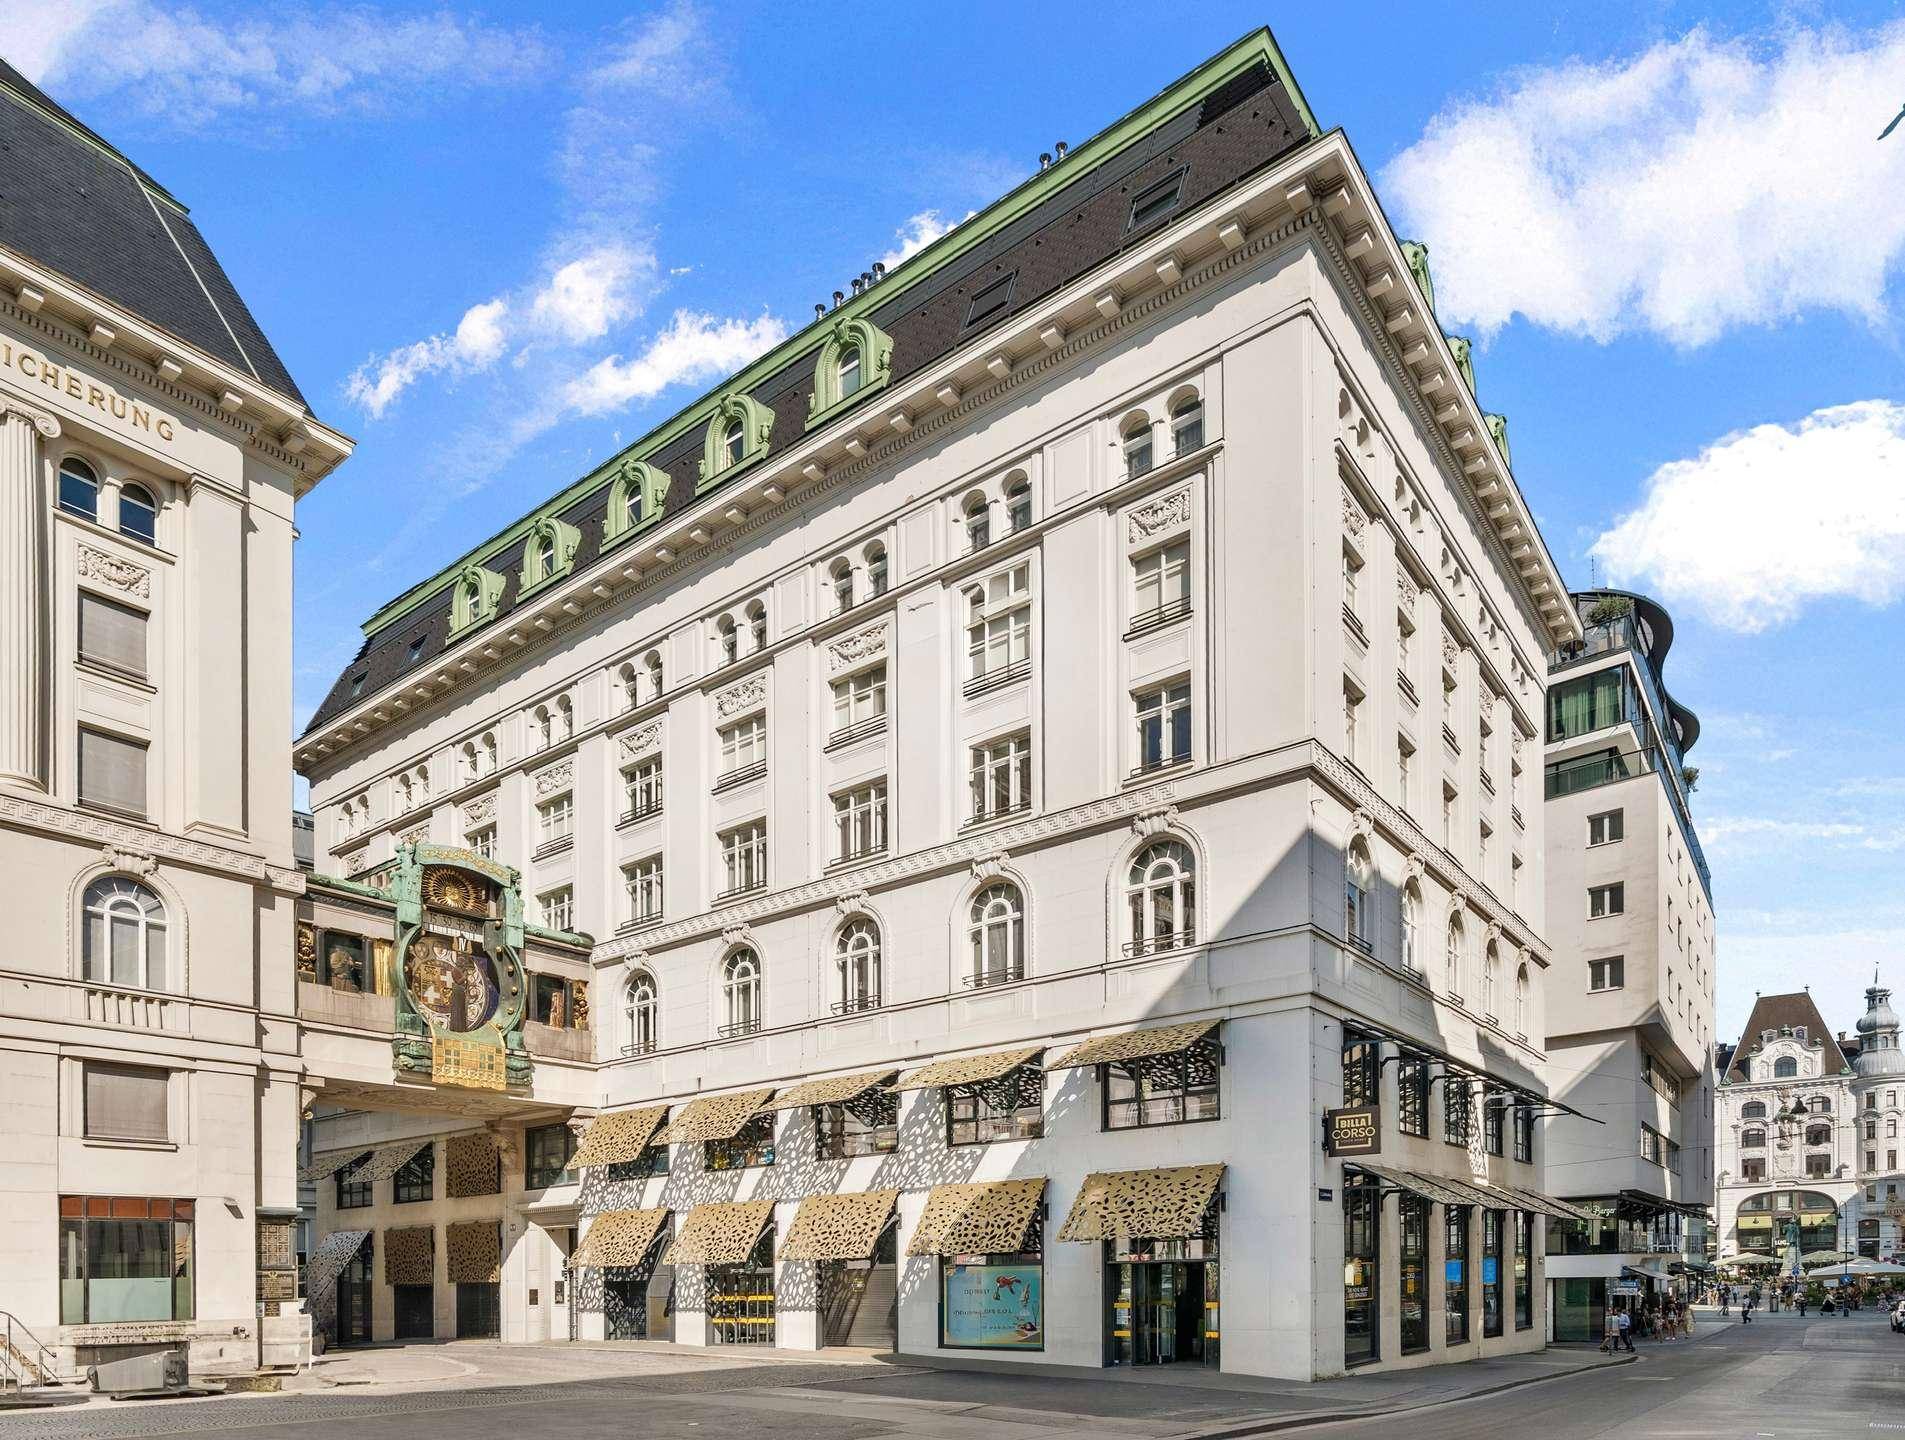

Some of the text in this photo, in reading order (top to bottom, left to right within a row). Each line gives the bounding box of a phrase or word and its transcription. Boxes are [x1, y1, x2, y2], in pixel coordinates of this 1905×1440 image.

[3, 343, 174, 441] ICHERUNG
[1340, 1118, 1366, 1128] BILLA
[1331, 1127, 1375, 1140] CORSO
